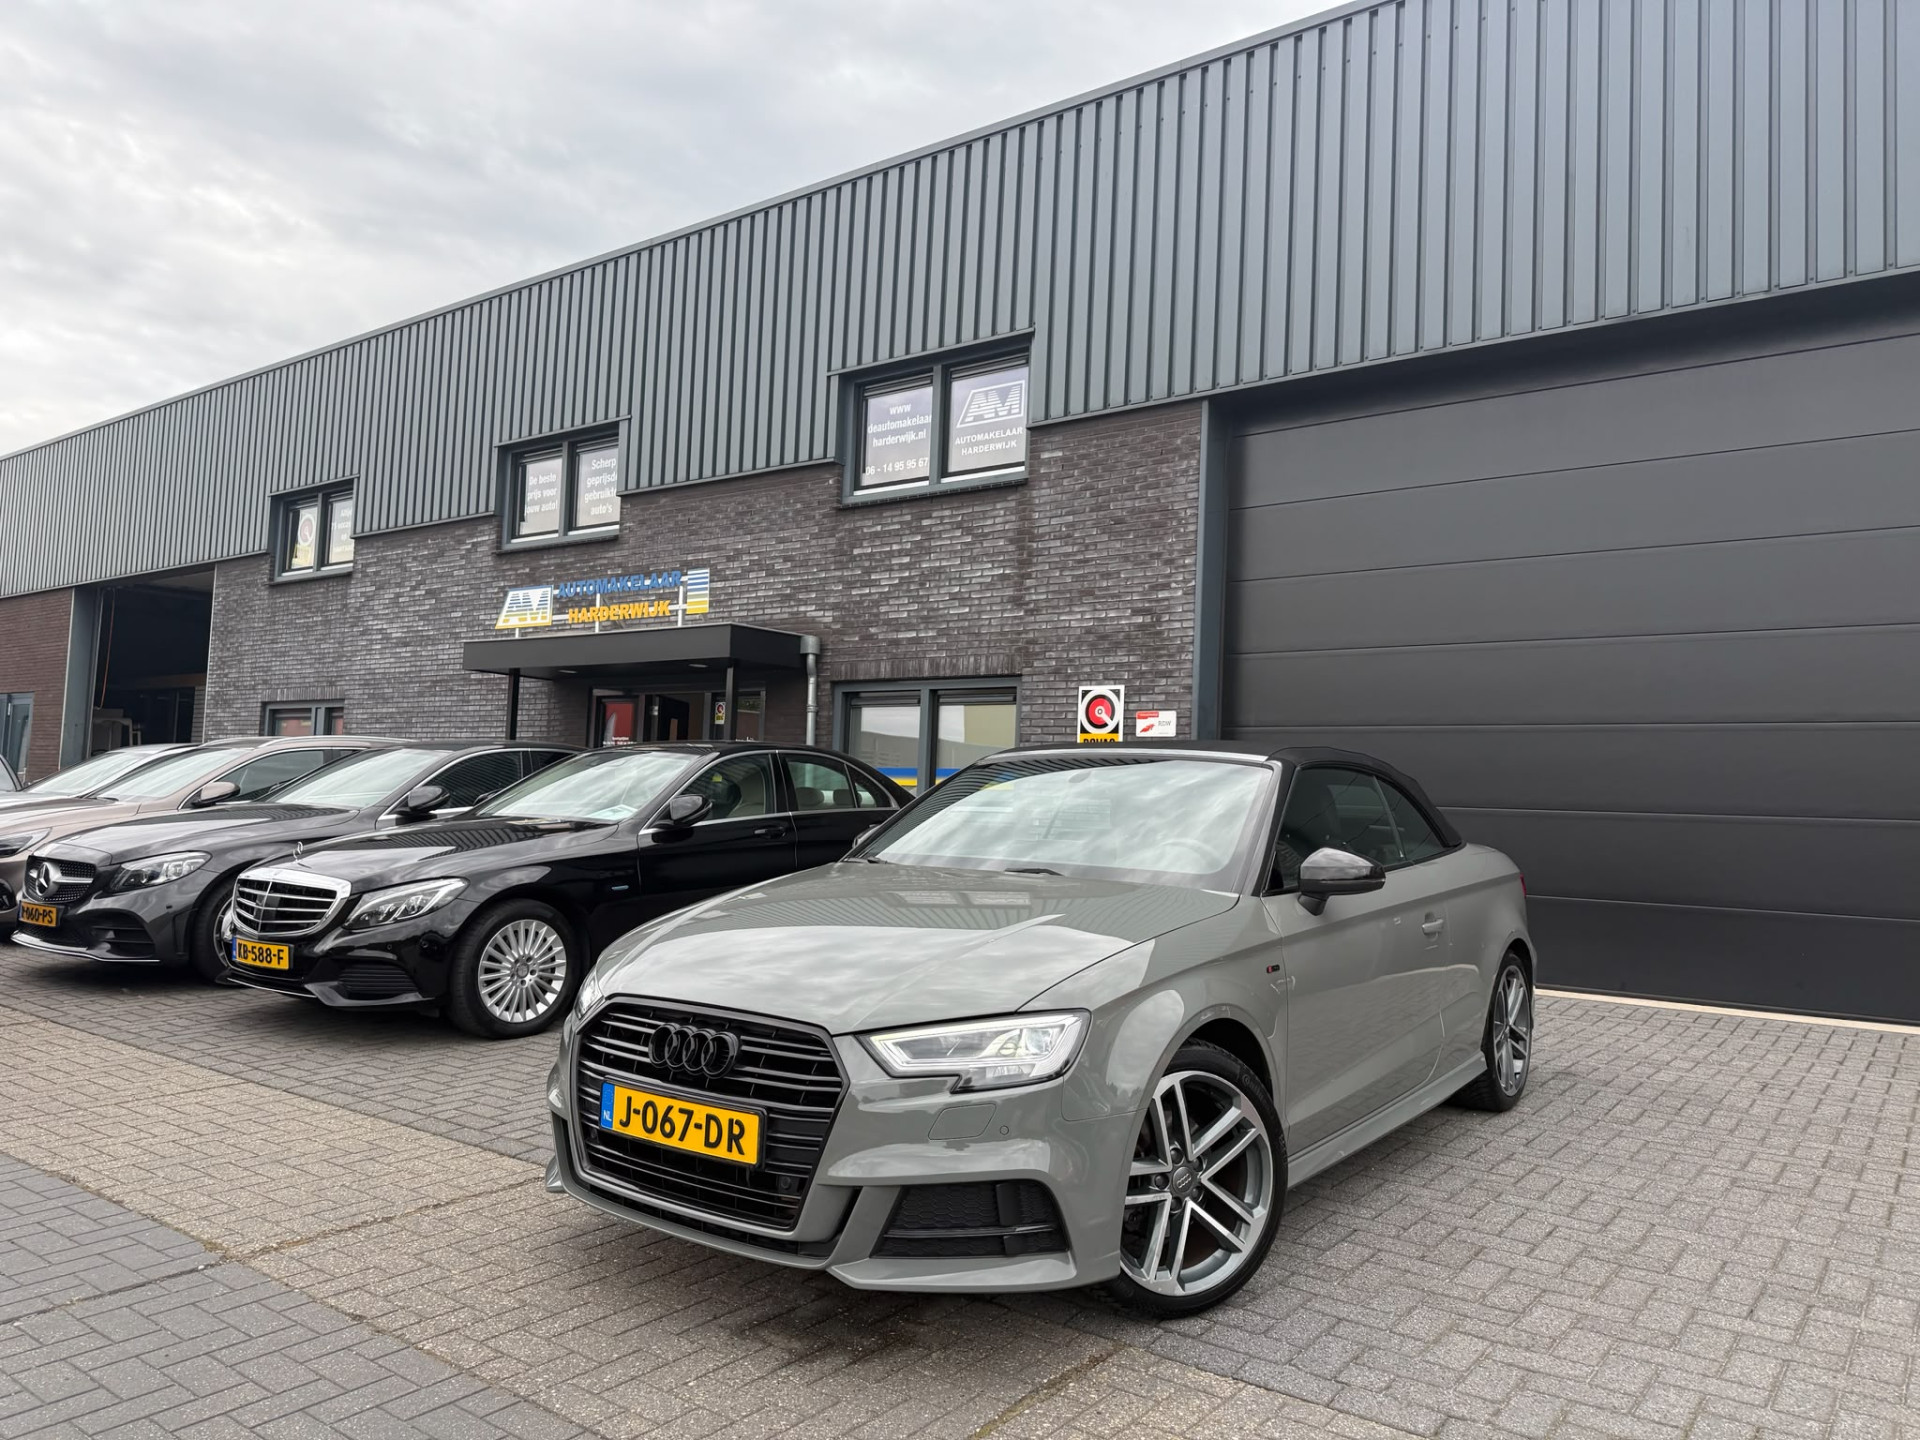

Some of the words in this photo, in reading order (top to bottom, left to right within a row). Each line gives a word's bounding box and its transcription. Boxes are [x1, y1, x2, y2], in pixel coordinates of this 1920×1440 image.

[890, 404, 912, 414] www
[872, 428, 926, 447] harderwijk.nl
[955, 427, 1023, 445] AUTOMAKELAAR
[961, 440, 1017, 456] HARDERWIJK
[591, 458, 616, 470] Scherp
[866, 466, 875, 476] 06
[883, 462, 892, 472] 14
[894, 461, 904, 471] 95
[906, 459, 916, 469] 95
[918, 457, 928, 467] 67
[586, 471, 617, 488] geprijsd
[543, 488, 557, 497] voor
[590, 503, 613, 515] auto's
[556, 570, 682, 598] AUTOMAKELAAR
[568, 600, 671, 624] HARDERWIJK
[238, 942, 284, 965] KB-588-F
[603, 1110, 612, 1122] NL
[619, 1096, 745, 1155] J-067-DR
